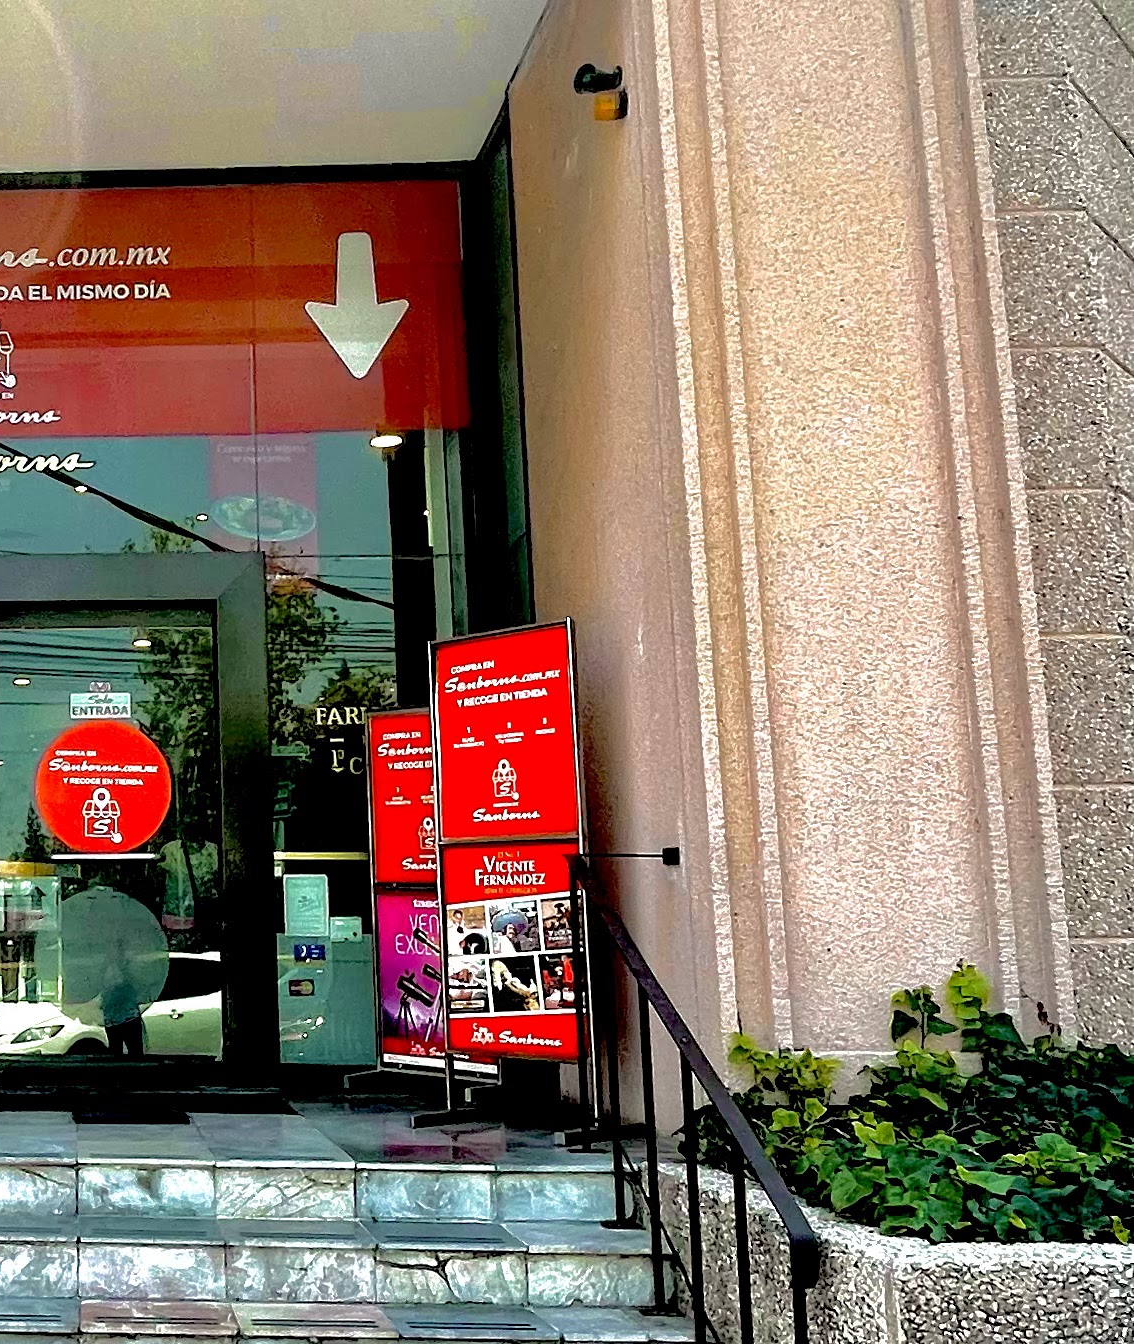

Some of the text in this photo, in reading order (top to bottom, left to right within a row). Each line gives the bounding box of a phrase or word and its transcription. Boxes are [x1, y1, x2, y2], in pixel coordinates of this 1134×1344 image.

[28, 285, 53, 301] EL
[57, 284, 130, 301] MISMO
[134, 279, 171, 300] DÍA
[2, 392, 14, 400] EN
[88, 694, 114, 704] Solo
[464, 694, 499, 707] RECOGE
[499, 691, 513, 702] EN
[514, 688, 548, 701] TIENDA
[72, 705, 129, 716] ENTRADA
[315, 706, 367, 726] FAR
[472, 808, 541, 823] Sanborns
[482, 855, 535, 873] VICENTE
[474, 869, 546, 886] FERNÁNDEZ
[498, 1030, 563, 1047] Sanborns
